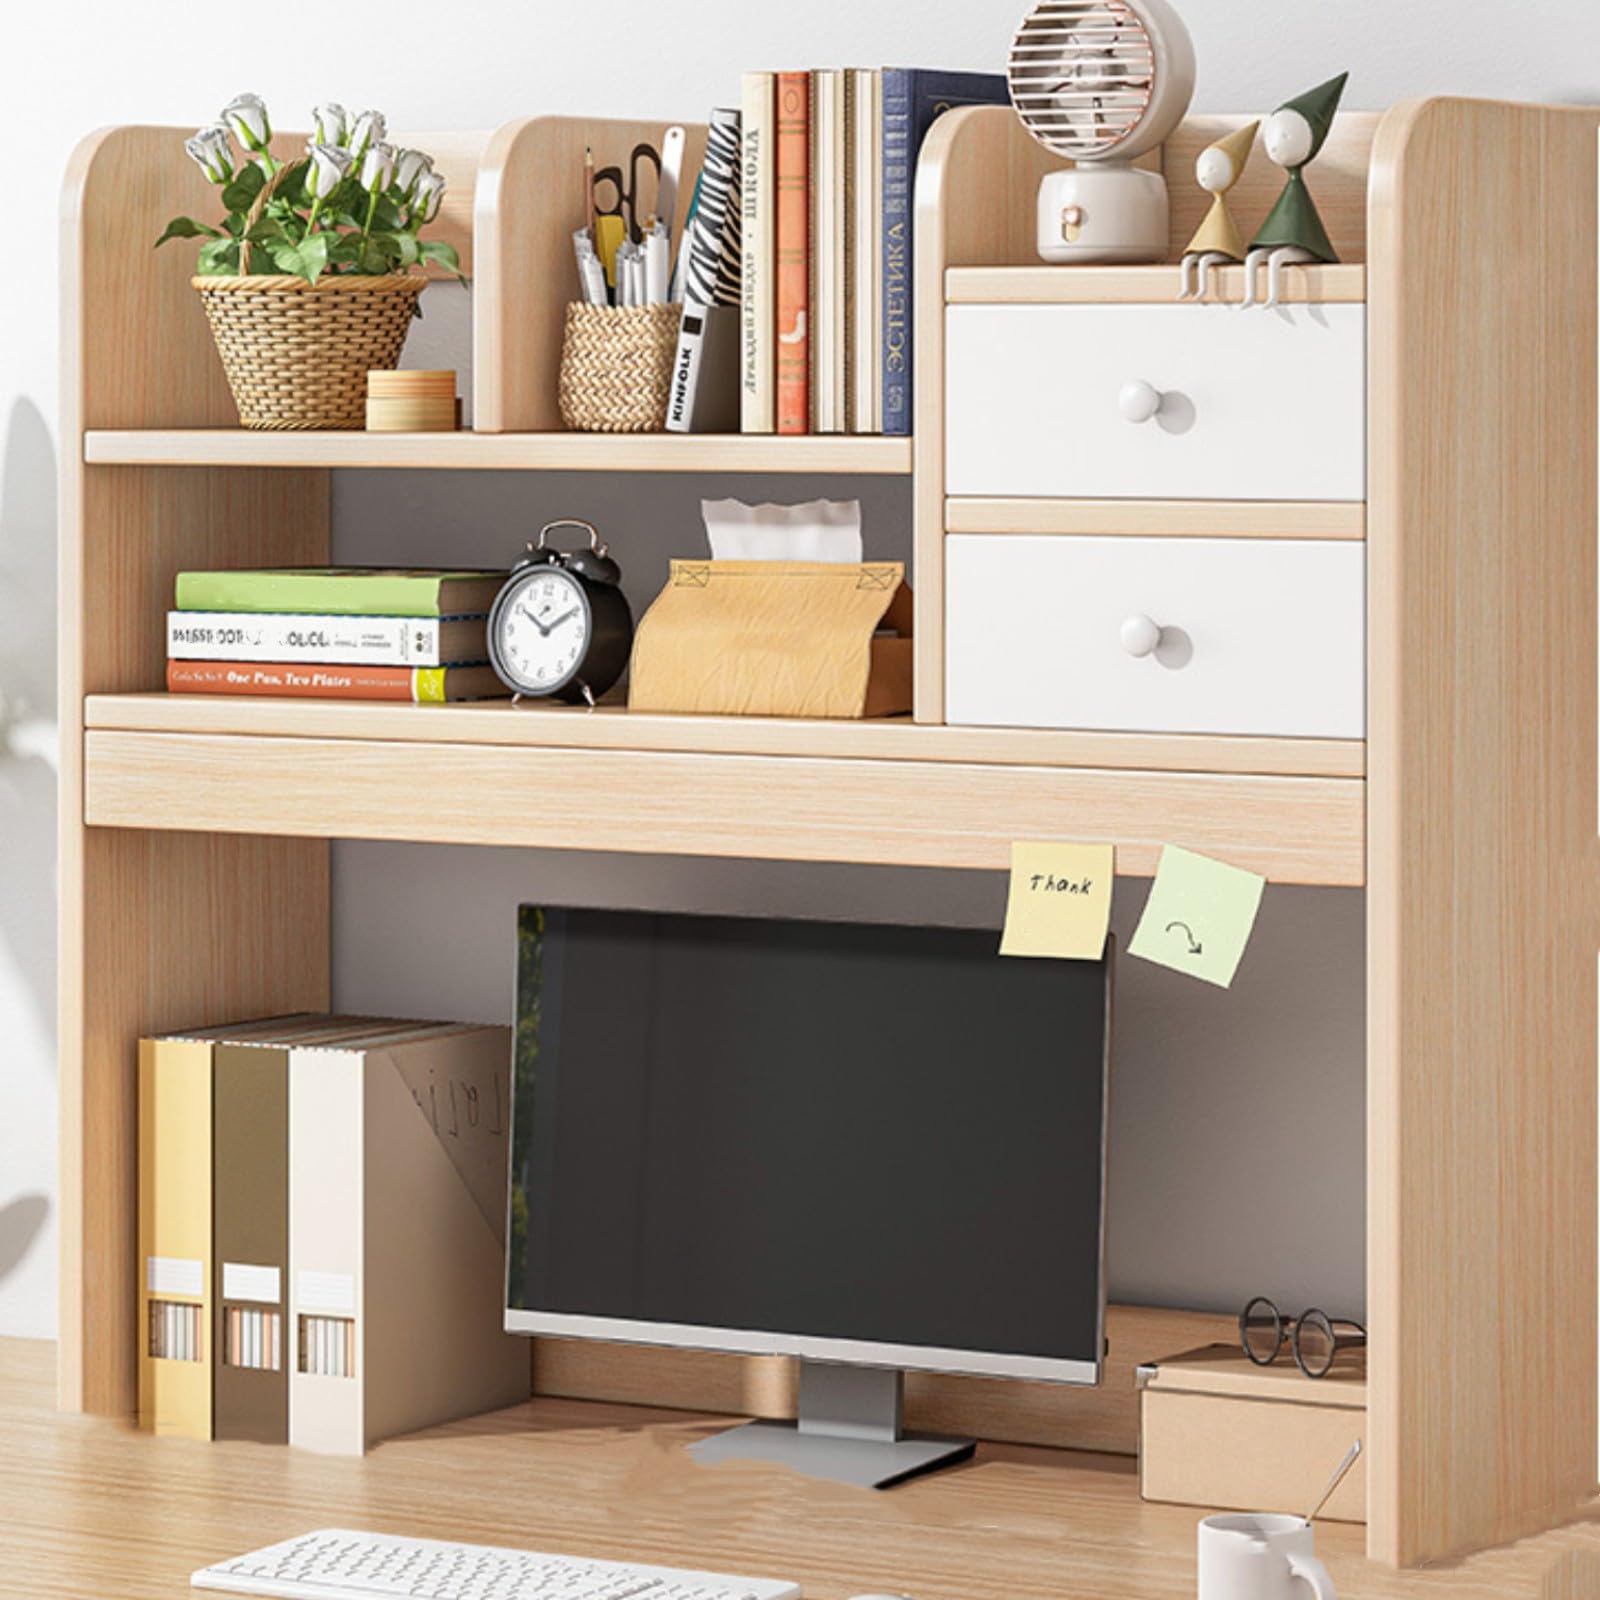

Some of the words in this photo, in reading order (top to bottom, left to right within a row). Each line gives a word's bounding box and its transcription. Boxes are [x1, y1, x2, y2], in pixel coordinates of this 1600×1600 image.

[744, 128, 760, 219] ШКОЛА
[886, 222, 905, 374] ЭСТЕТИКА
[672, 347, 692, 422] KINFOLK
[543, 583, 555, 597] 12
[226, 670, 250, 684] One
[284, 671, 310, 686] Two
[1030, 874, 1092, 895] Thank
